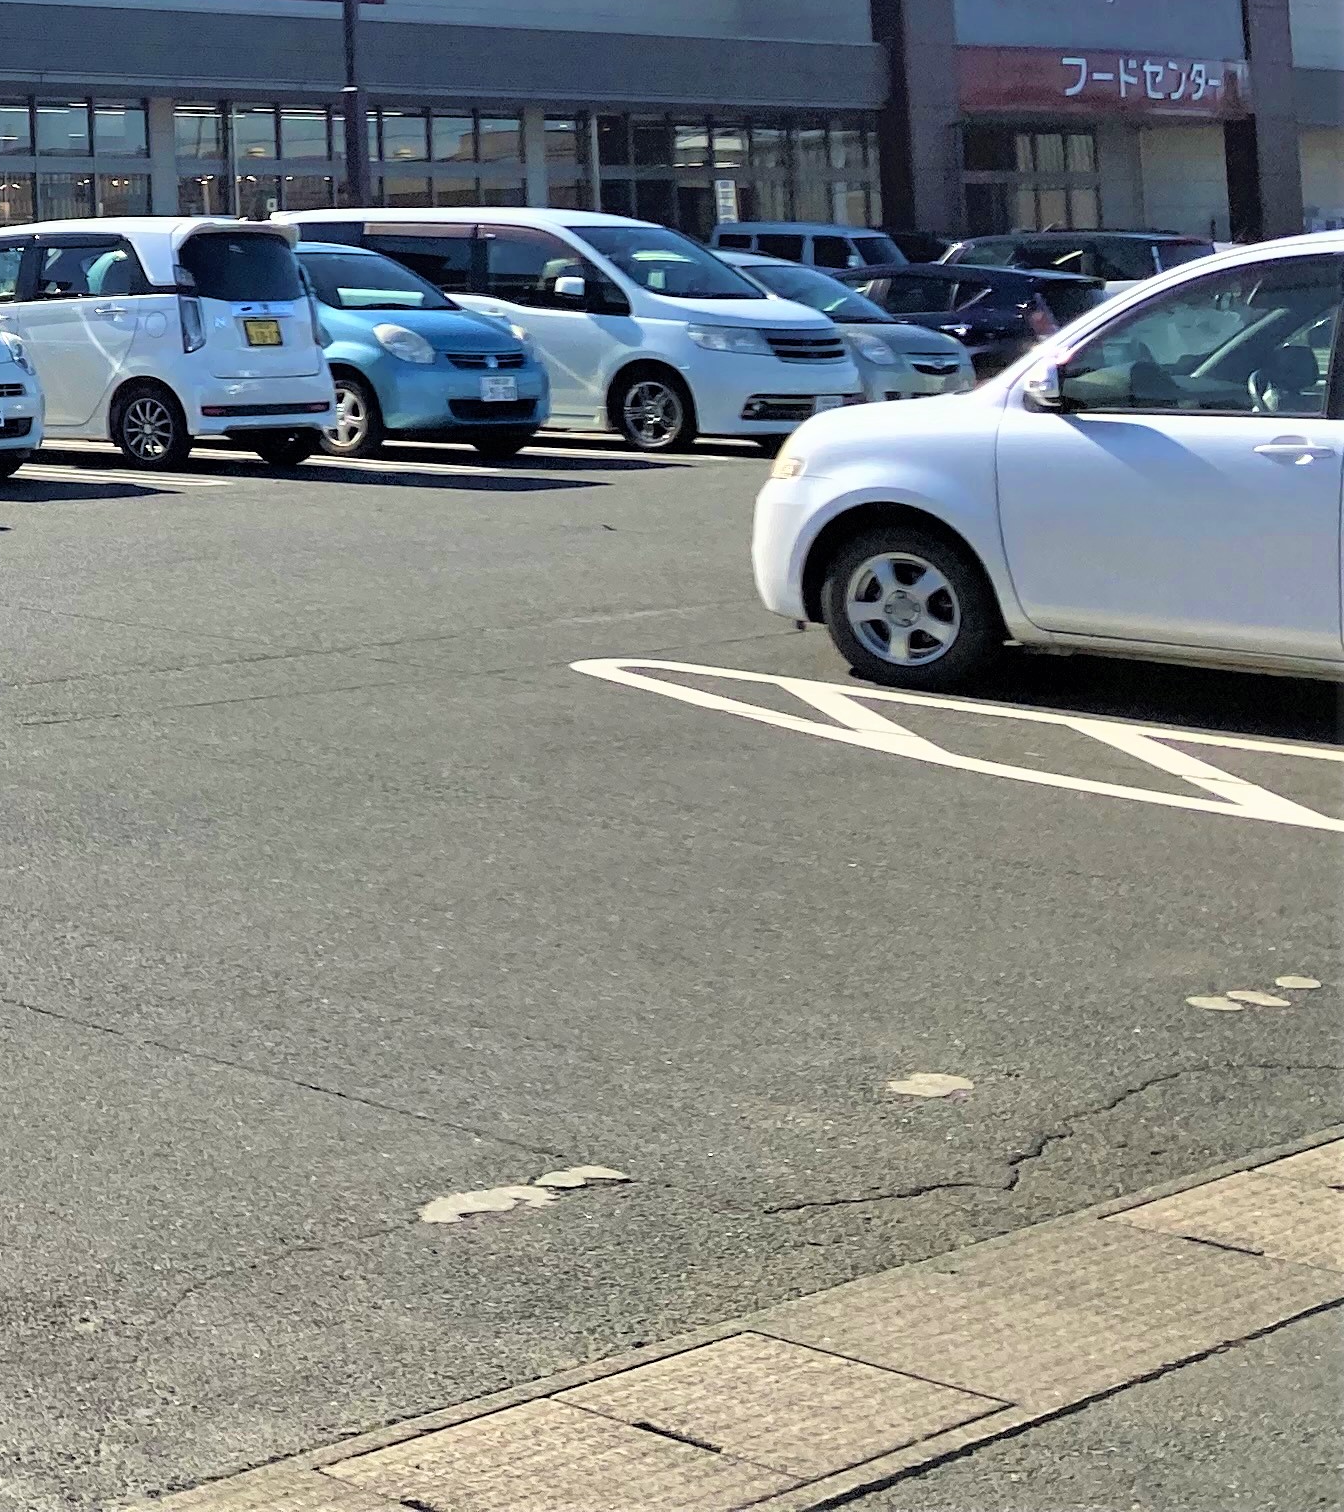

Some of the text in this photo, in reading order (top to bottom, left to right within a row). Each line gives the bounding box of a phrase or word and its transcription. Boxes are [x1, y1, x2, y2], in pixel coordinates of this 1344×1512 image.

[1061, 56, 1222, 101] フードセンター
